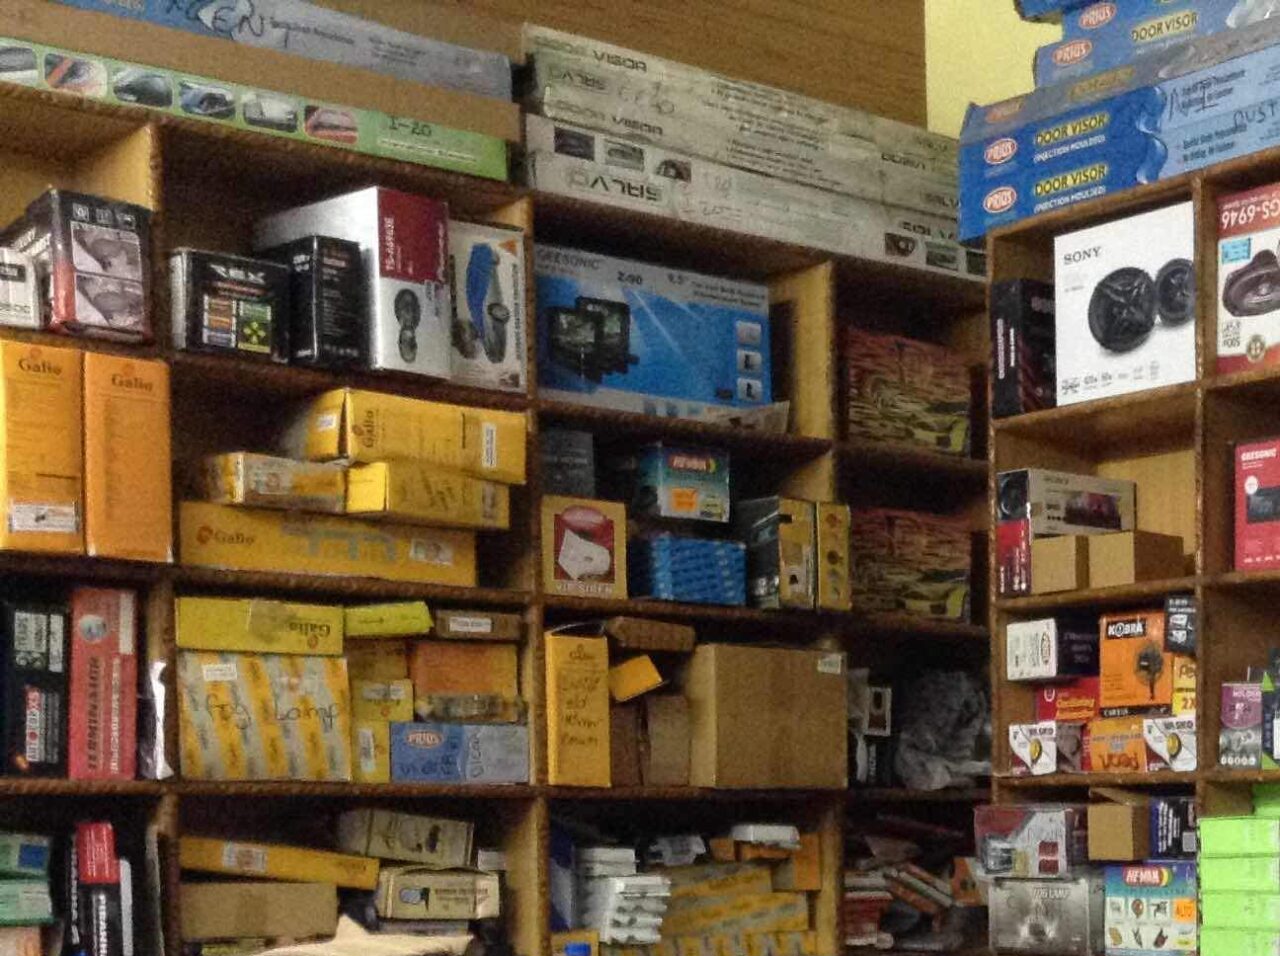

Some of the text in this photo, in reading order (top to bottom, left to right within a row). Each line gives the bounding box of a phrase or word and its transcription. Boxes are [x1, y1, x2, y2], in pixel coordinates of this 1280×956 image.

[1081, 6, 1115, 27] PRIUS
[1131, 12, 1198, 42] DOOR VISOR
[1055, 43, 1090, 63] PRIUS
[1035, 114, 1106, 146] DOOR VISOR
[1034, 164, 1106, 197] DOOR VISOR
[1063, 247, 1102, 265] SONY
[1106, 621, 1144, 638] KOBRA
